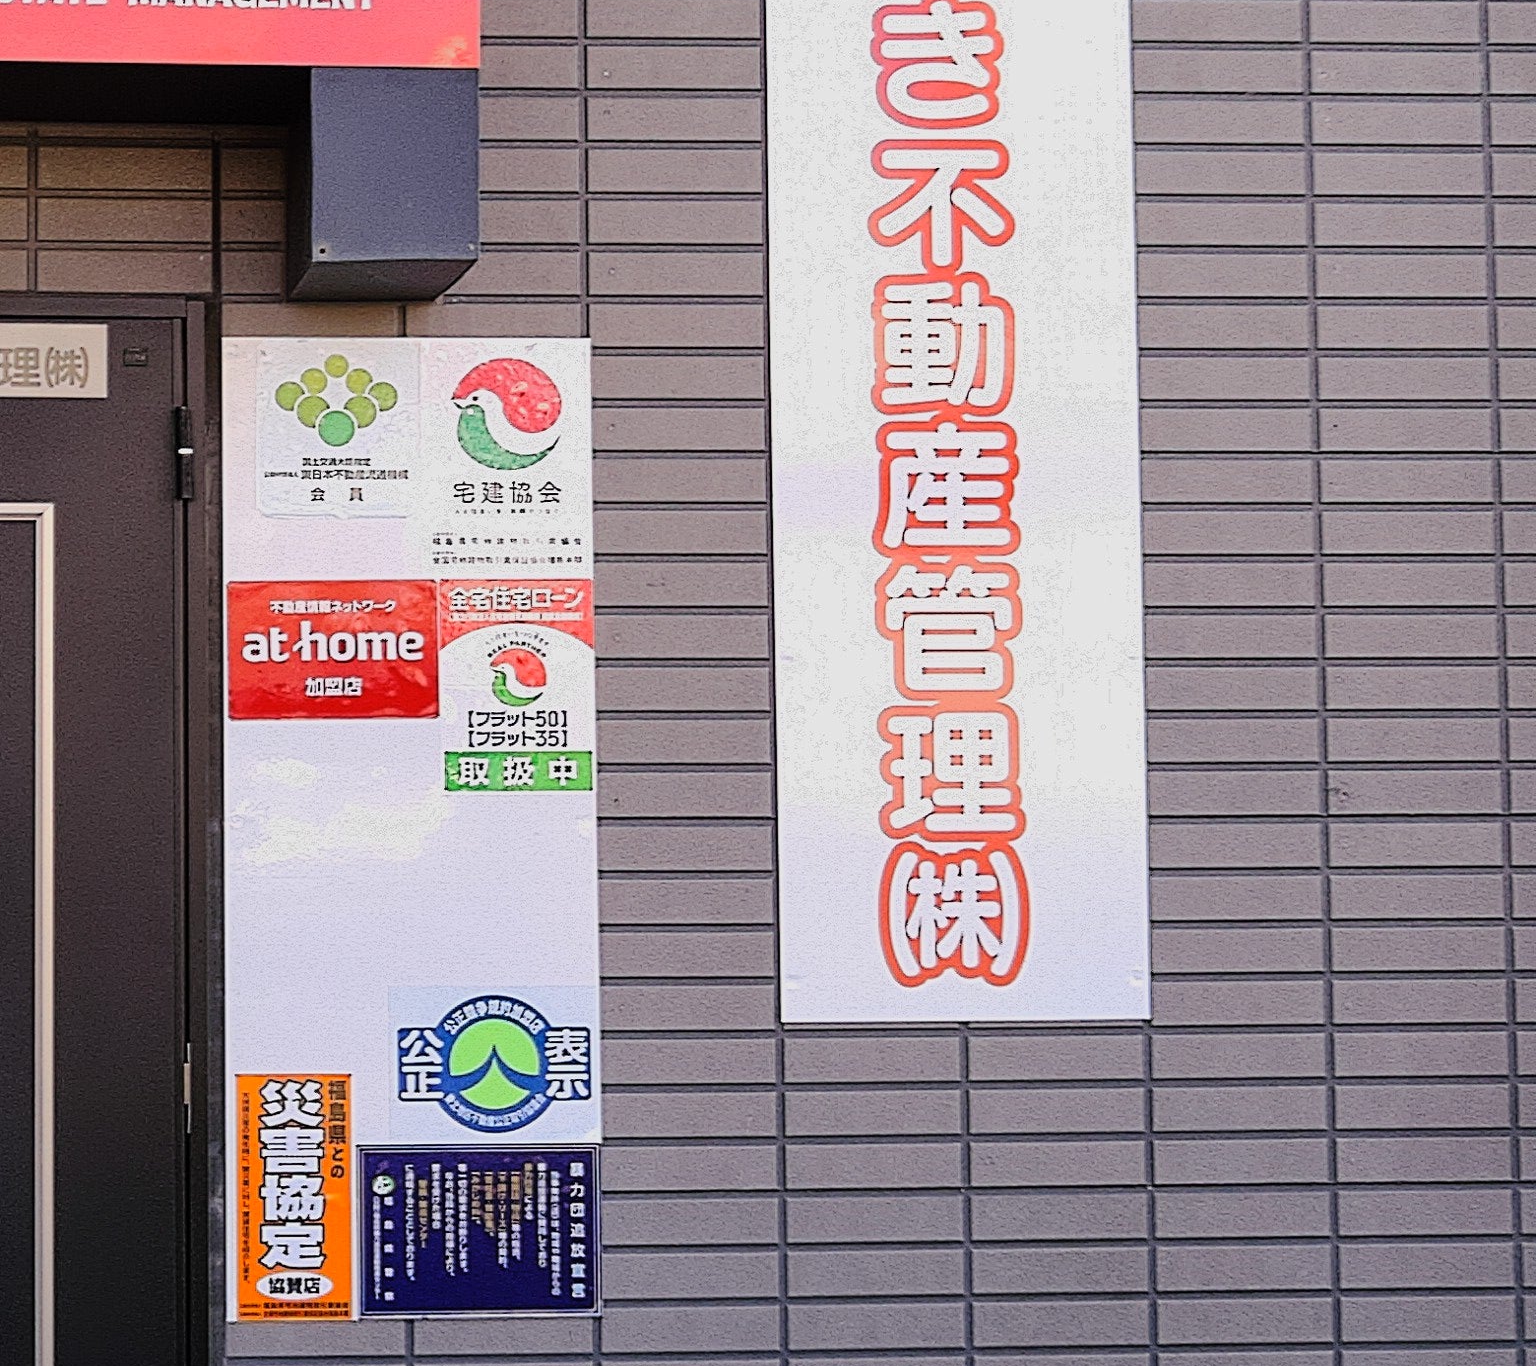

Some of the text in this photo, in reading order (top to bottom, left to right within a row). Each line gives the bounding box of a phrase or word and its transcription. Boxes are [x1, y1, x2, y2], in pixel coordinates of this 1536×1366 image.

[453, 480, 562, 504] 宅建協会
[448, 586, 584, 611] 全宅住宅ローン
[242, 620, 424, 662] at home
[305, 677, 363, 696] 加盟店
[458, 755, 578, 786] 取扱中
[400, 1029, 445, 1099] 公正
[544, 1028, 589, 1099] 表示
[258, 1079, 326, 1269] 災害協定
